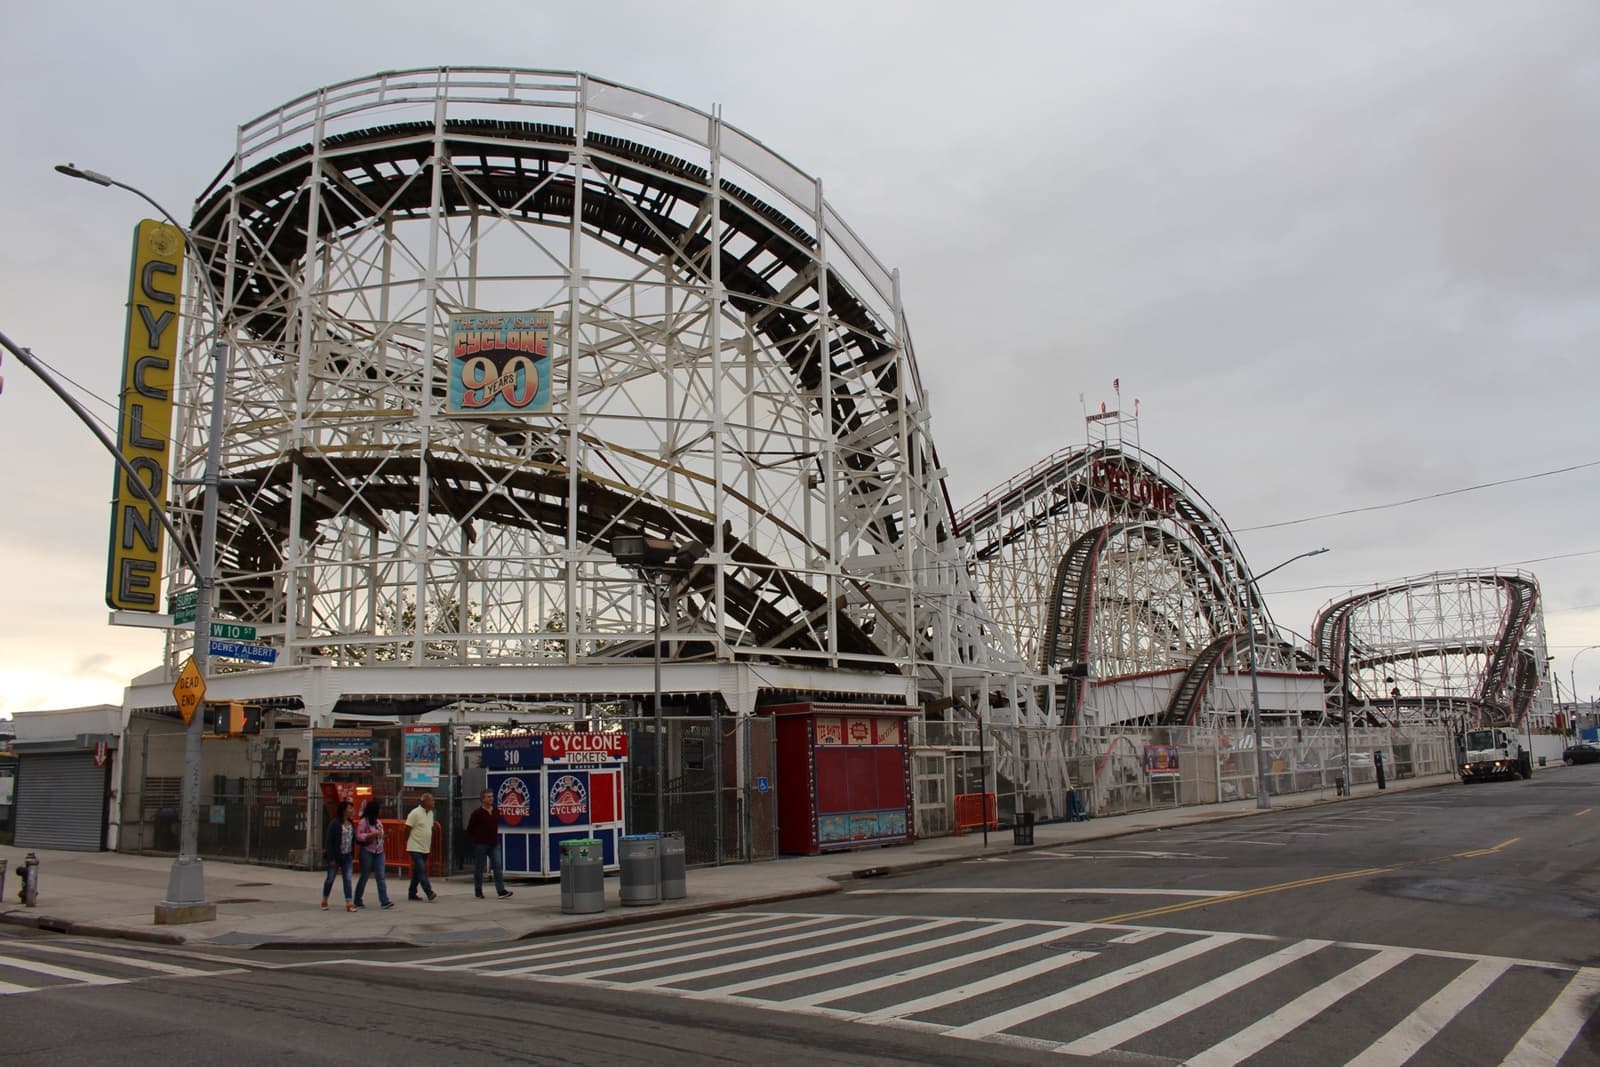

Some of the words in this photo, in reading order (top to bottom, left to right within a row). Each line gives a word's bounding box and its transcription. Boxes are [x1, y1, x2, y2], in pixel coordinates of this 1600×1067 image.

[454, 331, 549, 358] CYCLONE
[461, 356, 539, 409] 90
[487, 373, 515, 395] YEARS
[119, 260, 177, 602] CYCLONE
[1091, 459, 1175, 514] CYCLONE
[213, 625, 223, 636] W
[227, 626, 240, 638] 10
[244, 627, 252, 635] ST
[212, 641, 240, 655] DEWEY
[242, 646, 273, 657] ALBERT
[180, 676, 199, 689] DEAD
[181, 694, 195, 707] END
[550, 735, 622, 750] CYCLONE
[504, 750, 520, 765] $10
[566, 752, 608, 763] TICKETS
[550, 804, 588, 816] CYCLONE
